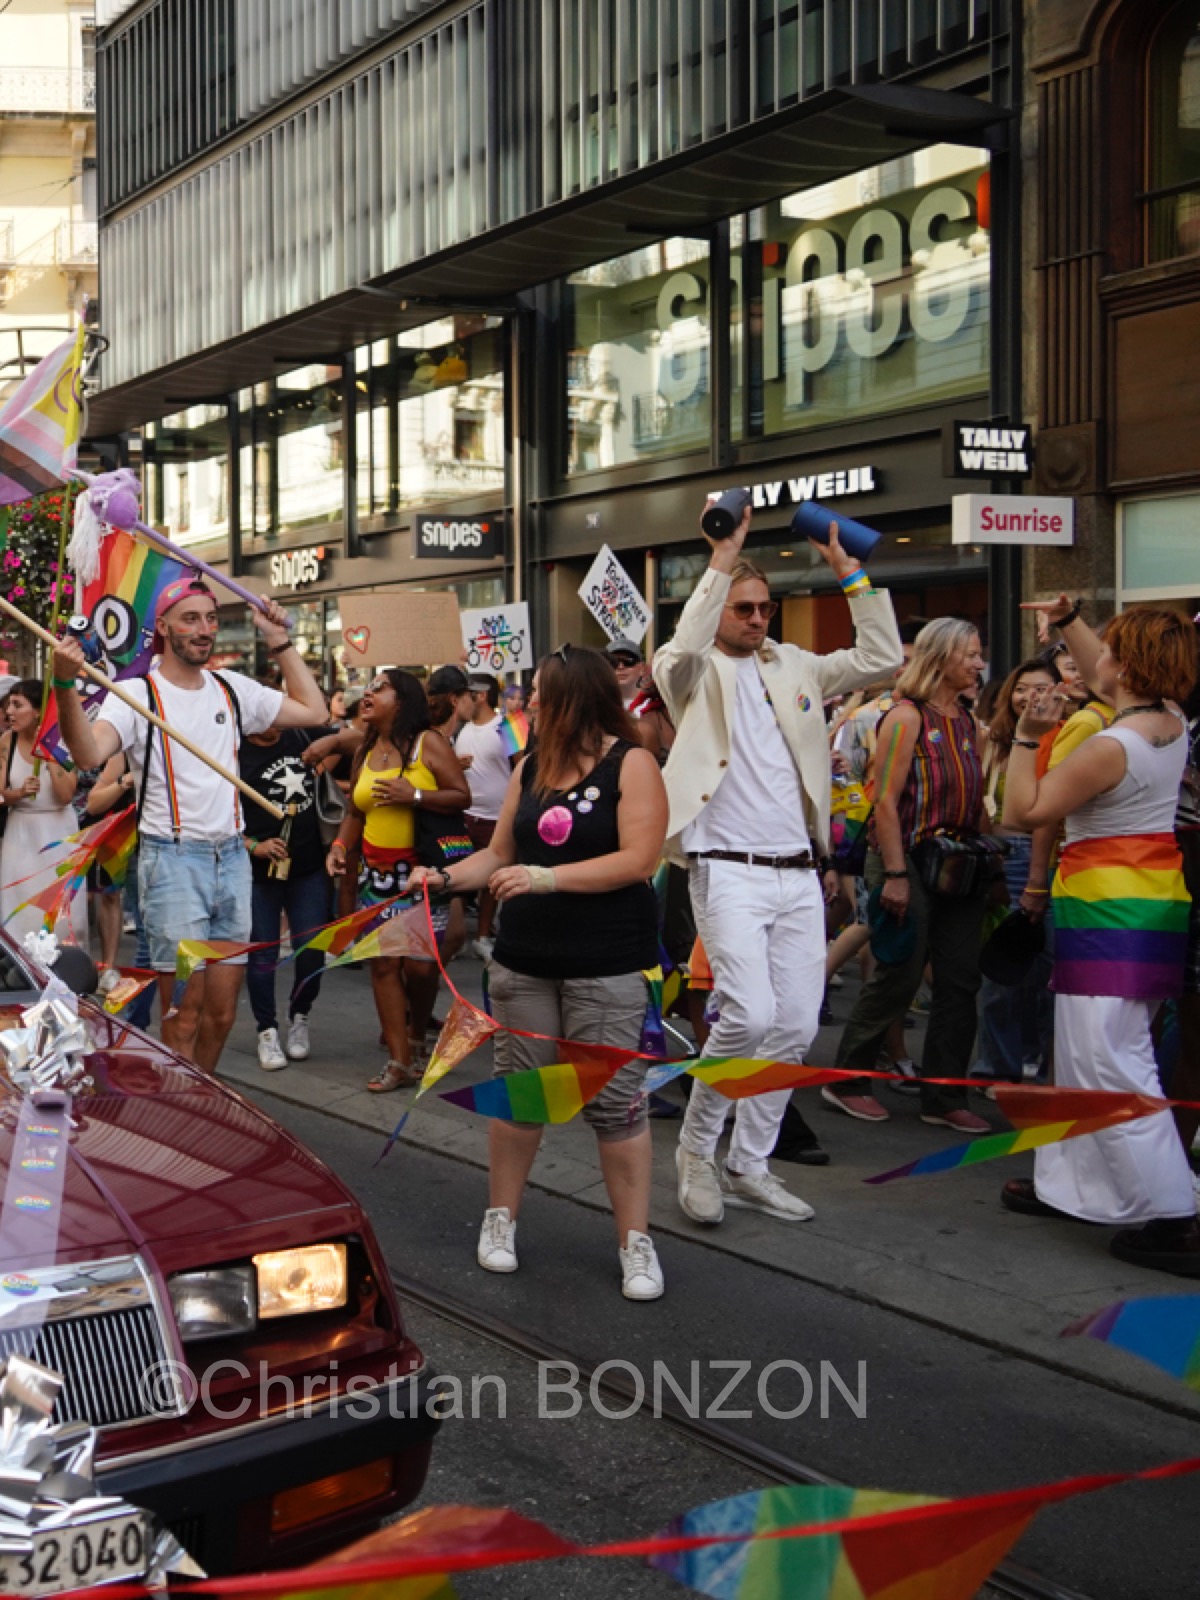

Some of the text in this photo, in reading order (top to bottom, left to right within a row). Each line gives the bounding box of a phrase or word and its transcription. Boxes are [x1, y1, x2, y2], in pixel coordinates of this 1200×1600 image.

[959, 427, 1027, 449] TALLY
[706, 481, 783, 509] TLY
[980, 506, 1063, 533] Sunrise
[422, 521, 485, 551] snipes
[270, 547, 322, 591] snipes
